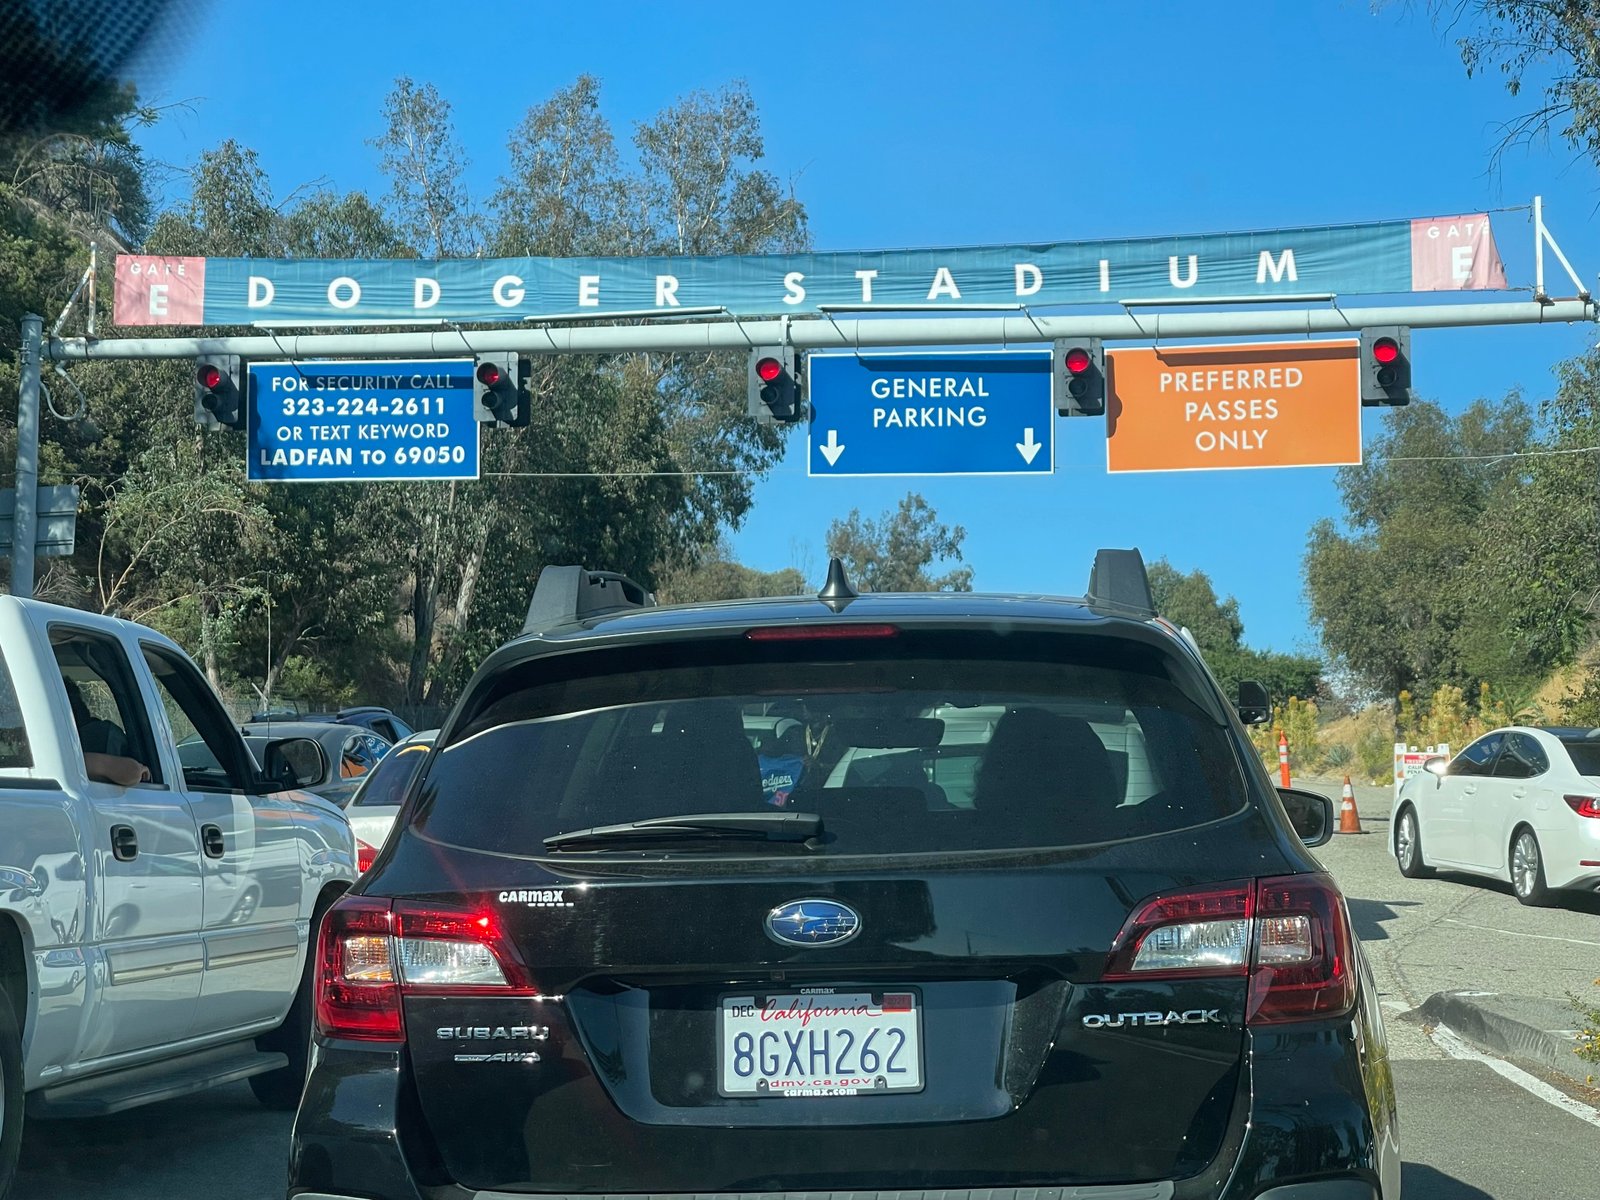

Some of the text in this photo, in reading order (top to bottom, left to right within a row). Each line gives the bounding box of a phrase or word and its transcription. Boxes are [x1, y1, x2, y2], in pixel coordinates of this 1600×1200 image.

[1427, 218, 1490, 239] GATE
[130, 262, 185, 276] GATE
[1451, 245, 1473, 280] E
[247, 247, 1299, 310] DODGER STADIUM
[149, 284, 169, 316] E
[271, 374, 455, 392] FOR SECURITY CALL
[870, 376, 990, 400] GENERAL
[1160, 366, 1304, 393] PREFERRED
[282, 397, 445, 416] 323-224-2611
[872, 404, 988, 429] PARKING
[1185, 398, 1279, 423] PASSES
[276, 423, 450, 441] OR TEXT KEYWORD
[1194, 428, 1269, 453] ONLY
[260, 445, 466, 467] LADFAN TO 69050
[762, 773, 793, 793] odgers
[732, 997, 883, 1027] DEC California
[1083, 1009, 1221, 1028] OUTBACK
[436, 1025, 550, 1040] SUBARU
[485, 1052, 541, 1062] AWD
[733, 1027, 907, 1077] 8GXH262
[770, 1077, 872, 1088] dmv.ca.gov
[783, 1087, 858, 1097] carmax.com
